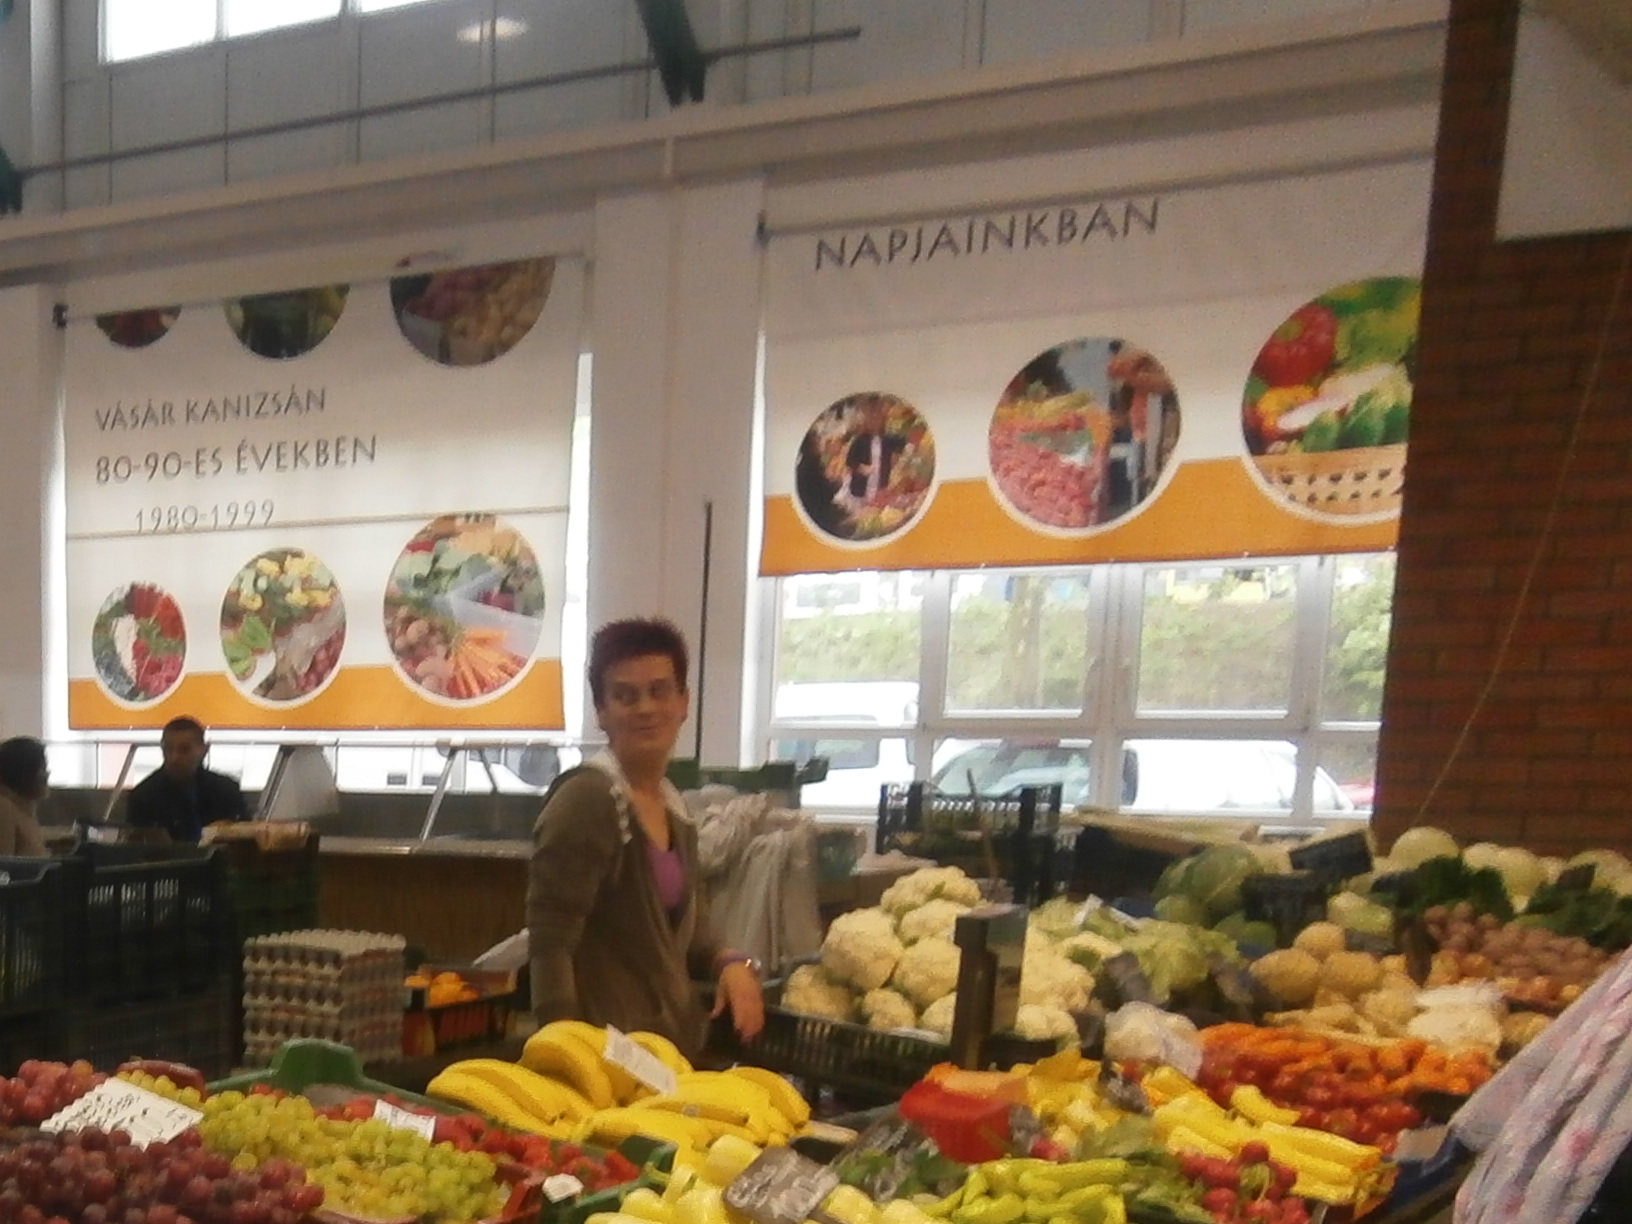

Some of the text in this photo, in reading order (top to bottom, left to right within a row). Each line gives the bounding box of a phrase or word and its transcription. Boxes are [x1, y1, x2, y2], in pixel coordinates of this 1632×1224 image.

[815, 198, 1160, 272] NAPJAINKBAN
[95, 385, 327, 432] VÁSÁR KANIZSÁN
[95, 439, 378, 486] 80-90-ES ÉVEKBEN
[134, 499, 276, 534] 1980-1999
